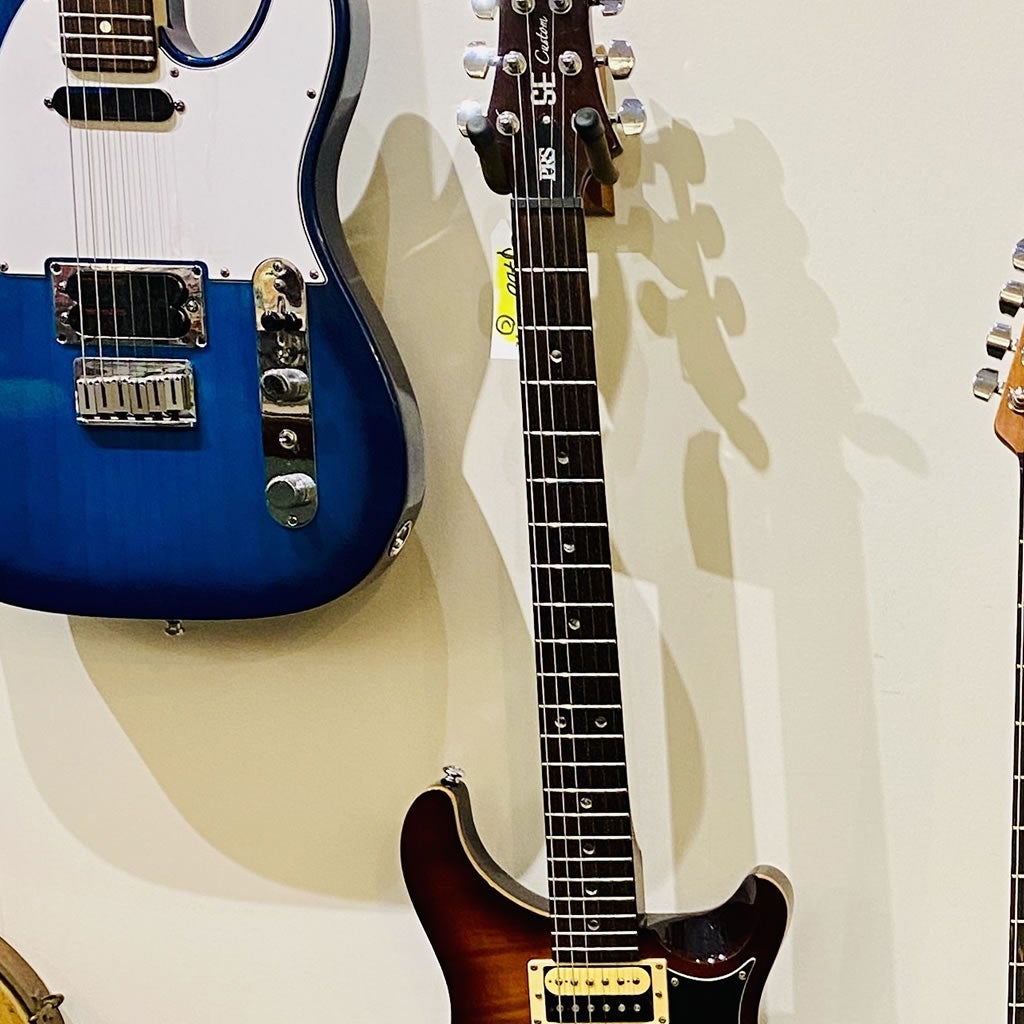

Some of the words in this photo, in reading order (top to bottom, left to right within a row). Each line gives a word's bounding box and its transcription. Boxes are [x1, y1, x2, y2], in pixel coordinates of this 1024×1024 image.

[534, 15, 549, 65] Custom
[531, 72, 557, 106] SE
[538, 147, 556, 182] PRS
